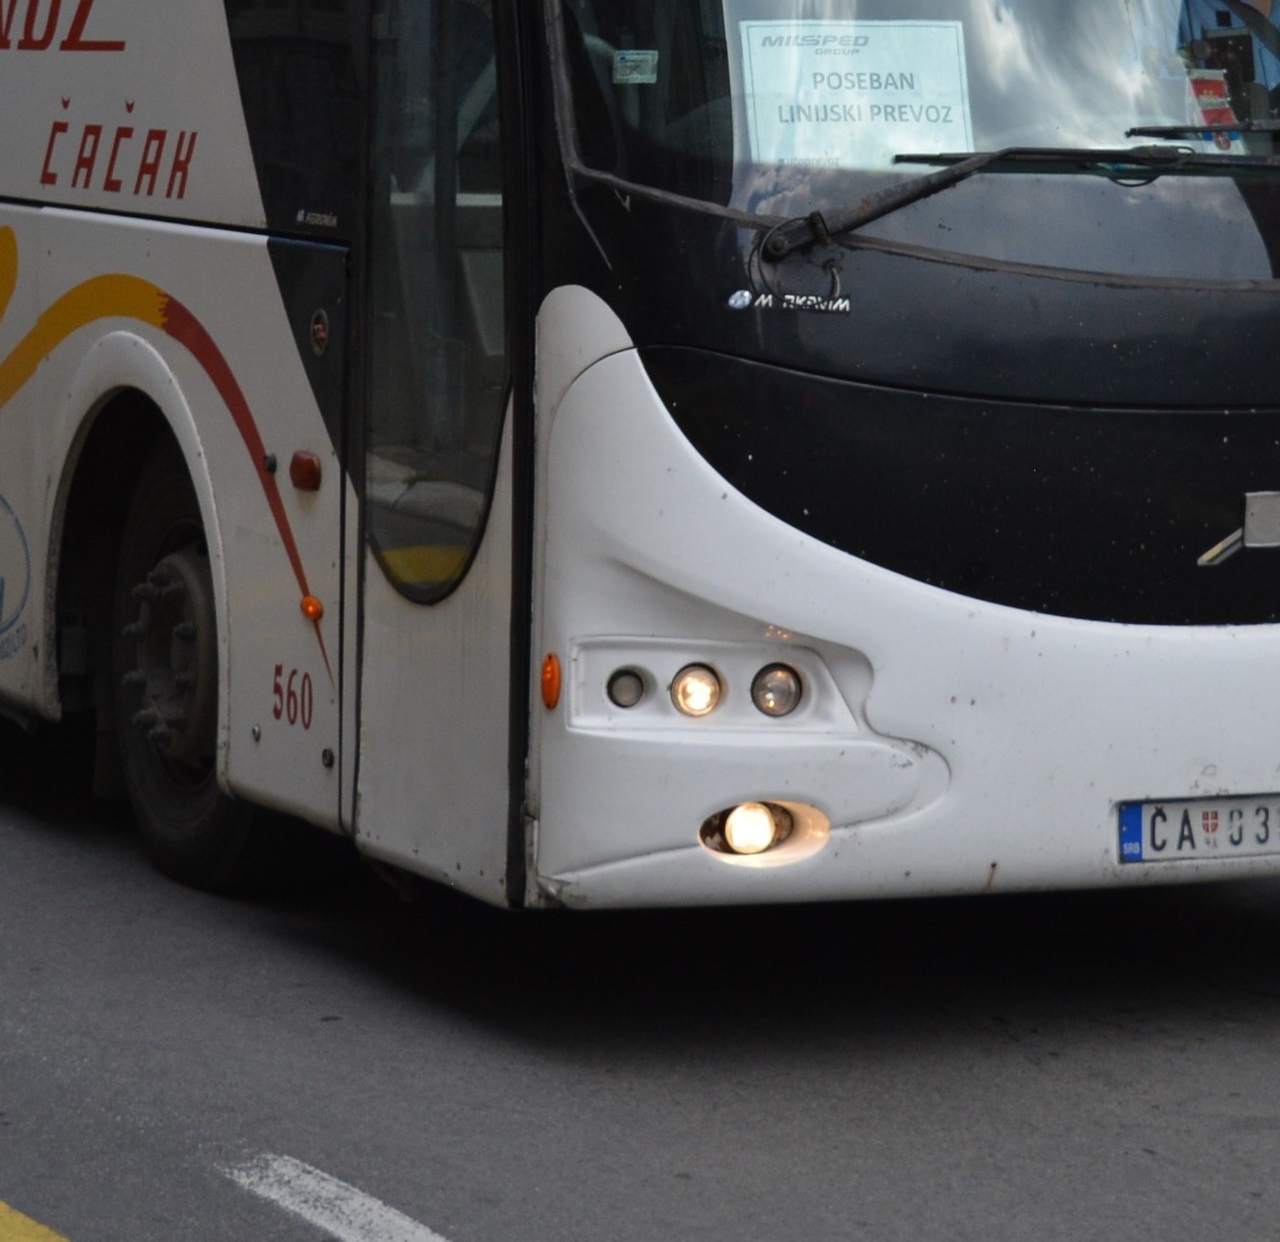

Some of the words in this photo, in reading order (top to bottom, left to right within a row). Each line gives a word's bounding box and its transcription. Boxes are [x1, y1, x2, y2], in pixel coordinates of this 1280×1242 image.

[811, 72, 915, 91] POSEBAN
[777, 104, 863, 124] LINIJSKI
[869, 104, 954, 124] PREVOZ
[39, 96, 198, 200] ČAČAK
[272, 663, 314, 730] 560
[1122, 842, 1141, 855] SRB
